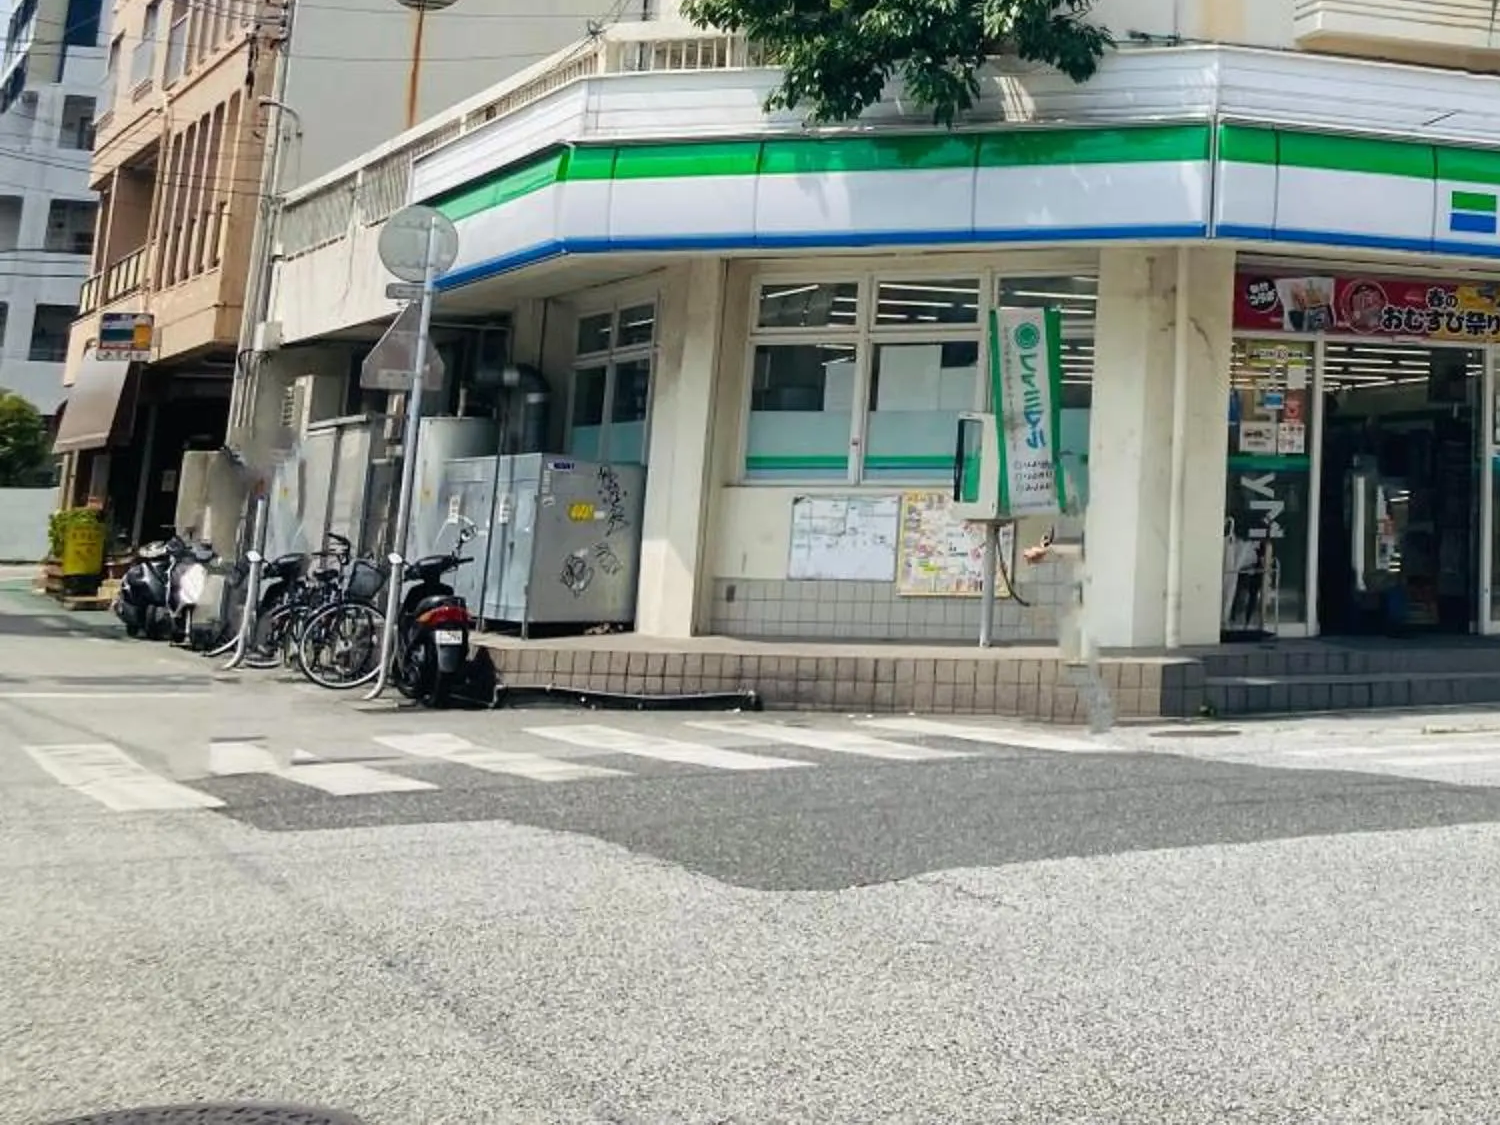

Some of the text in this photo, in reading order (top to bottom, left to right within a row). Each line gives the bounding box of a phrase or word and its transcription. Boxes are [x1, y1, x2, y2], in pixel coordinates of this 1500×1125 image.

[1427, 287, 1458, 308] 春の
[1382, 305, 1500, 335] おむすび祭り
